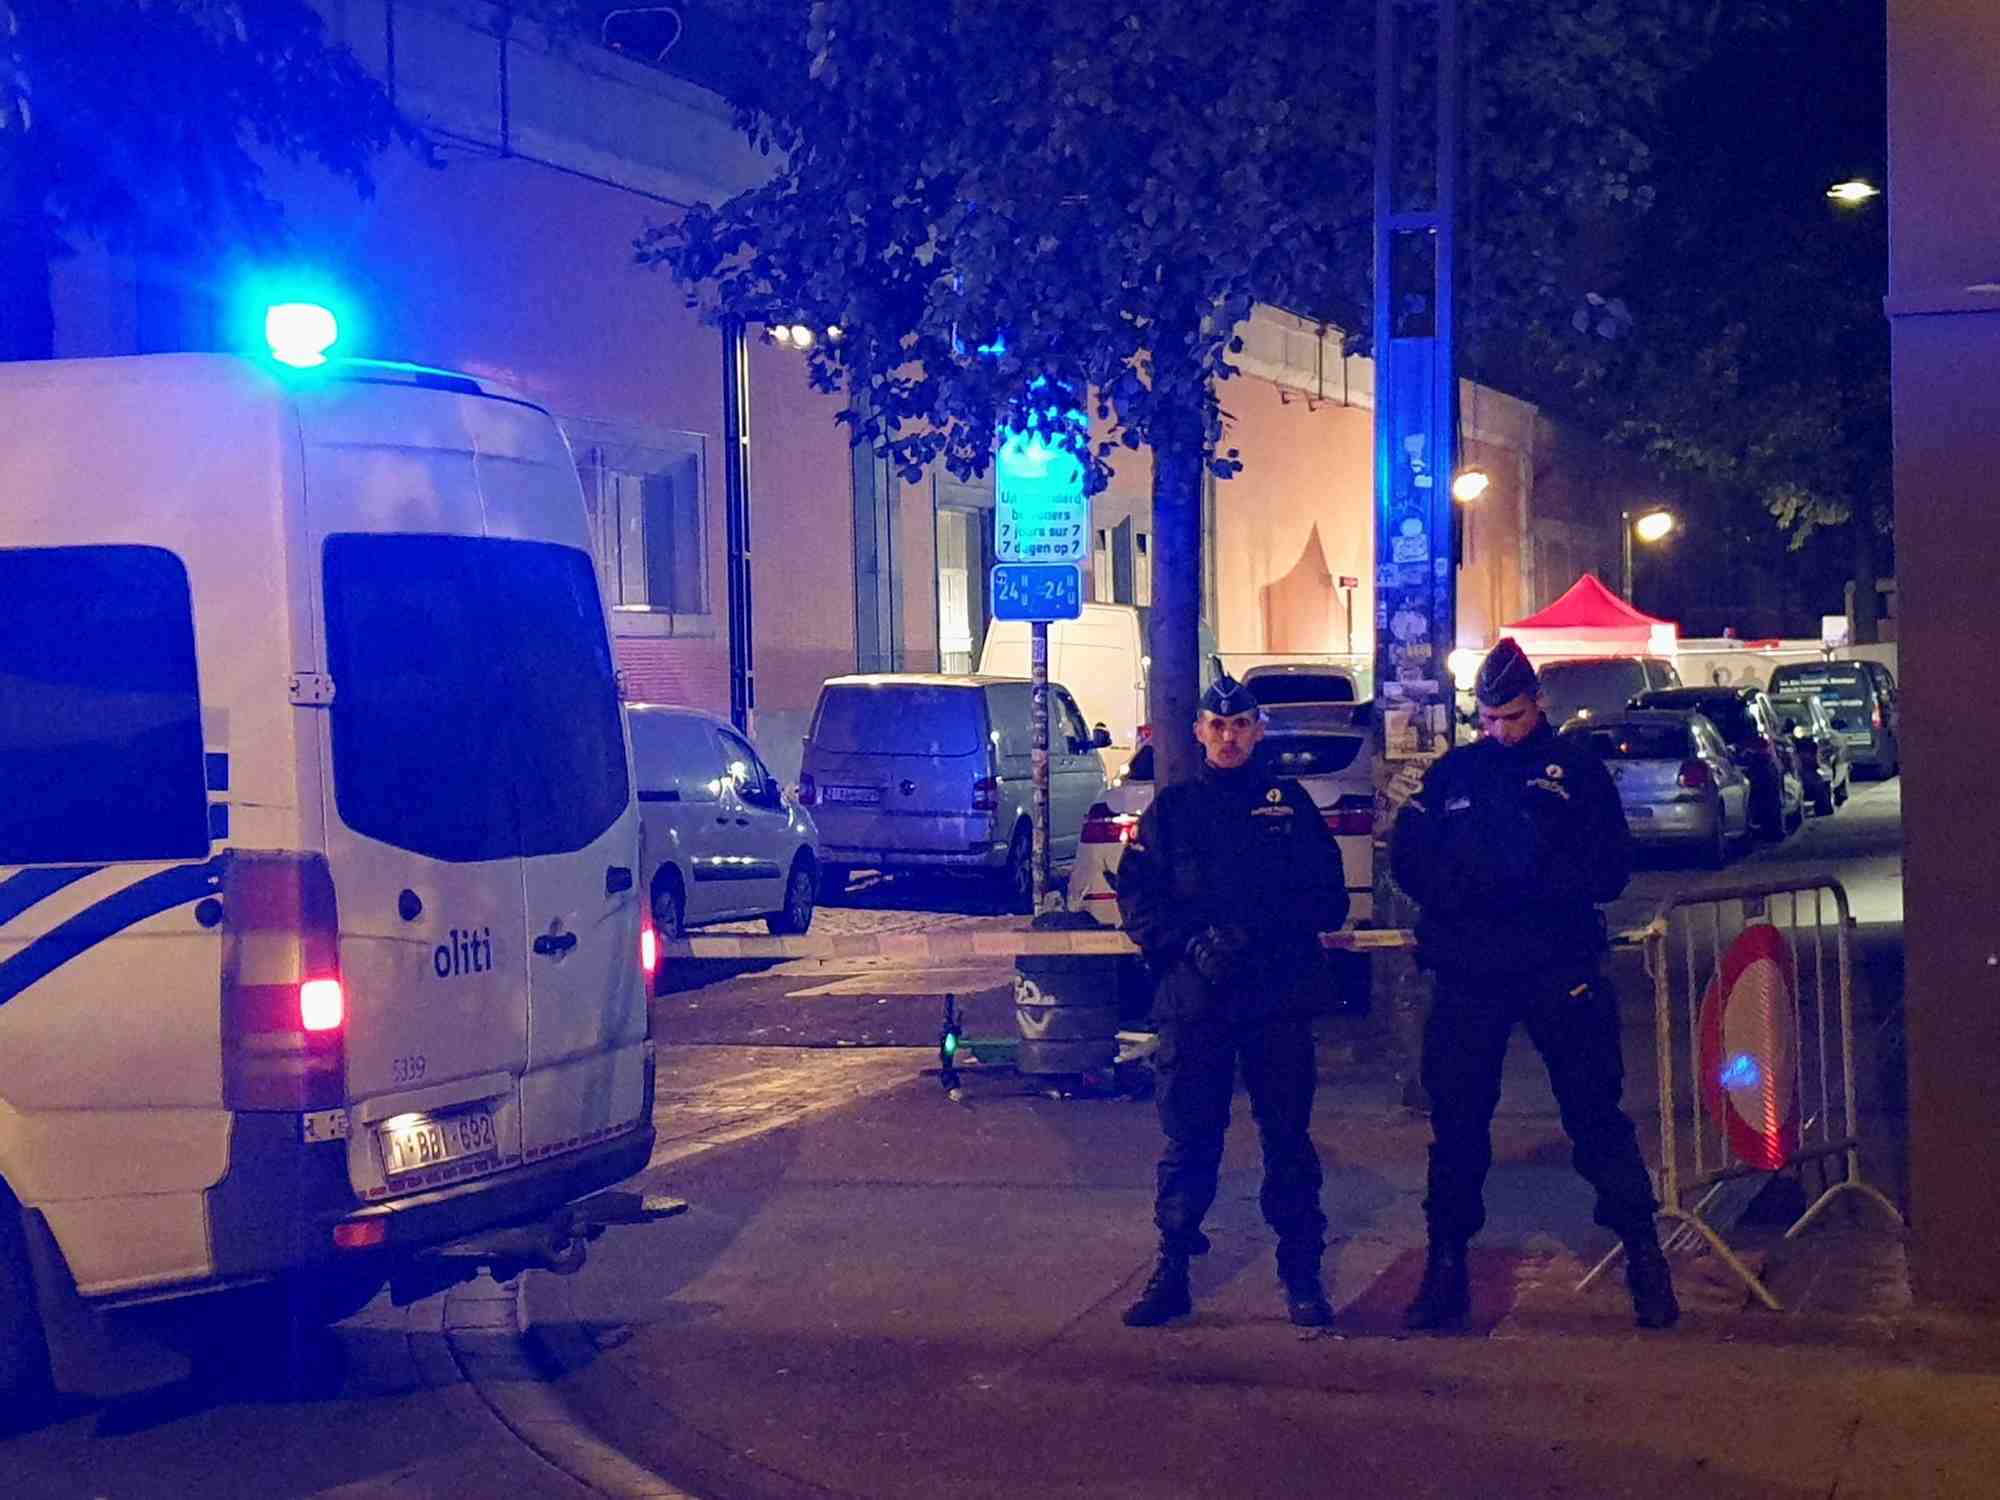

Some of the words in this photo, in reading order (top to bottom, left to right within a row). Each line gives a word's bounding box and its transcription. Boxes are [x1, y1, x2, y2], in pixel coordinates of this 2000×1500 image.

[1002, 524, 1010, 537] 7
[1049, 527, 1068, 537] sur
[1072, 524, 1081, 537] 7
[1002, 541, 1011, 553] 7
[1054, 543, 1069, 556] op
[1072, 540, 1081, 553] 7
[434, 927, 493, 978] oliti
